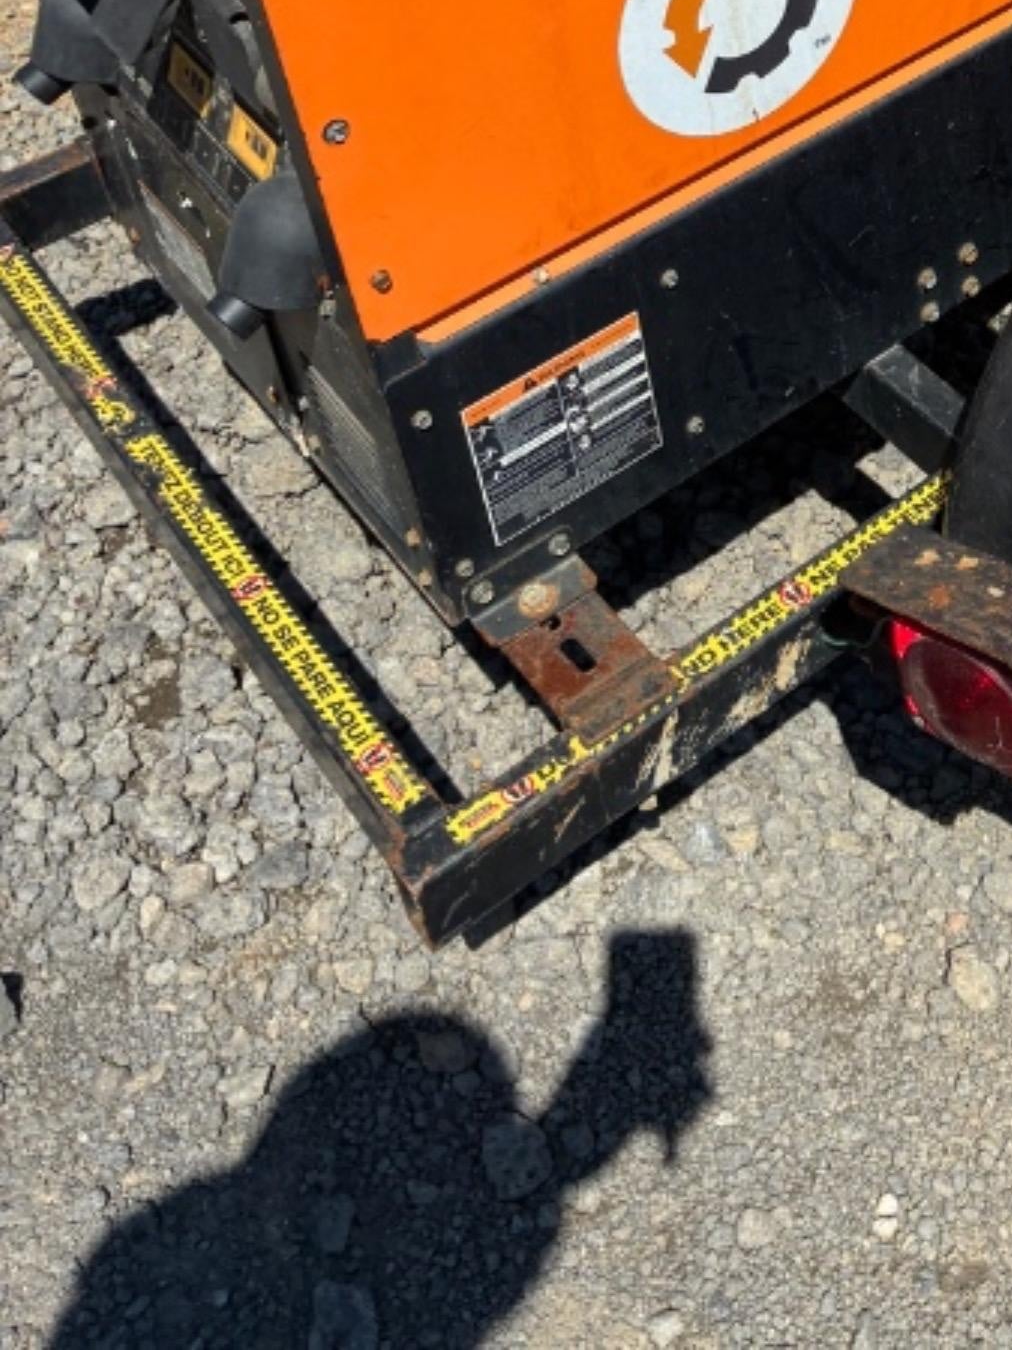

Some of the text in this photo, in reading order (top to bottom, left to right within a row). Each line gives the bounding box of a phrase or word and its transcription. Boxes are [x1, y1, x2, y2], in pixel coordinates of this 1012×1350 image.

[252, 595, 371, 747] NO SE PARE AQUI
